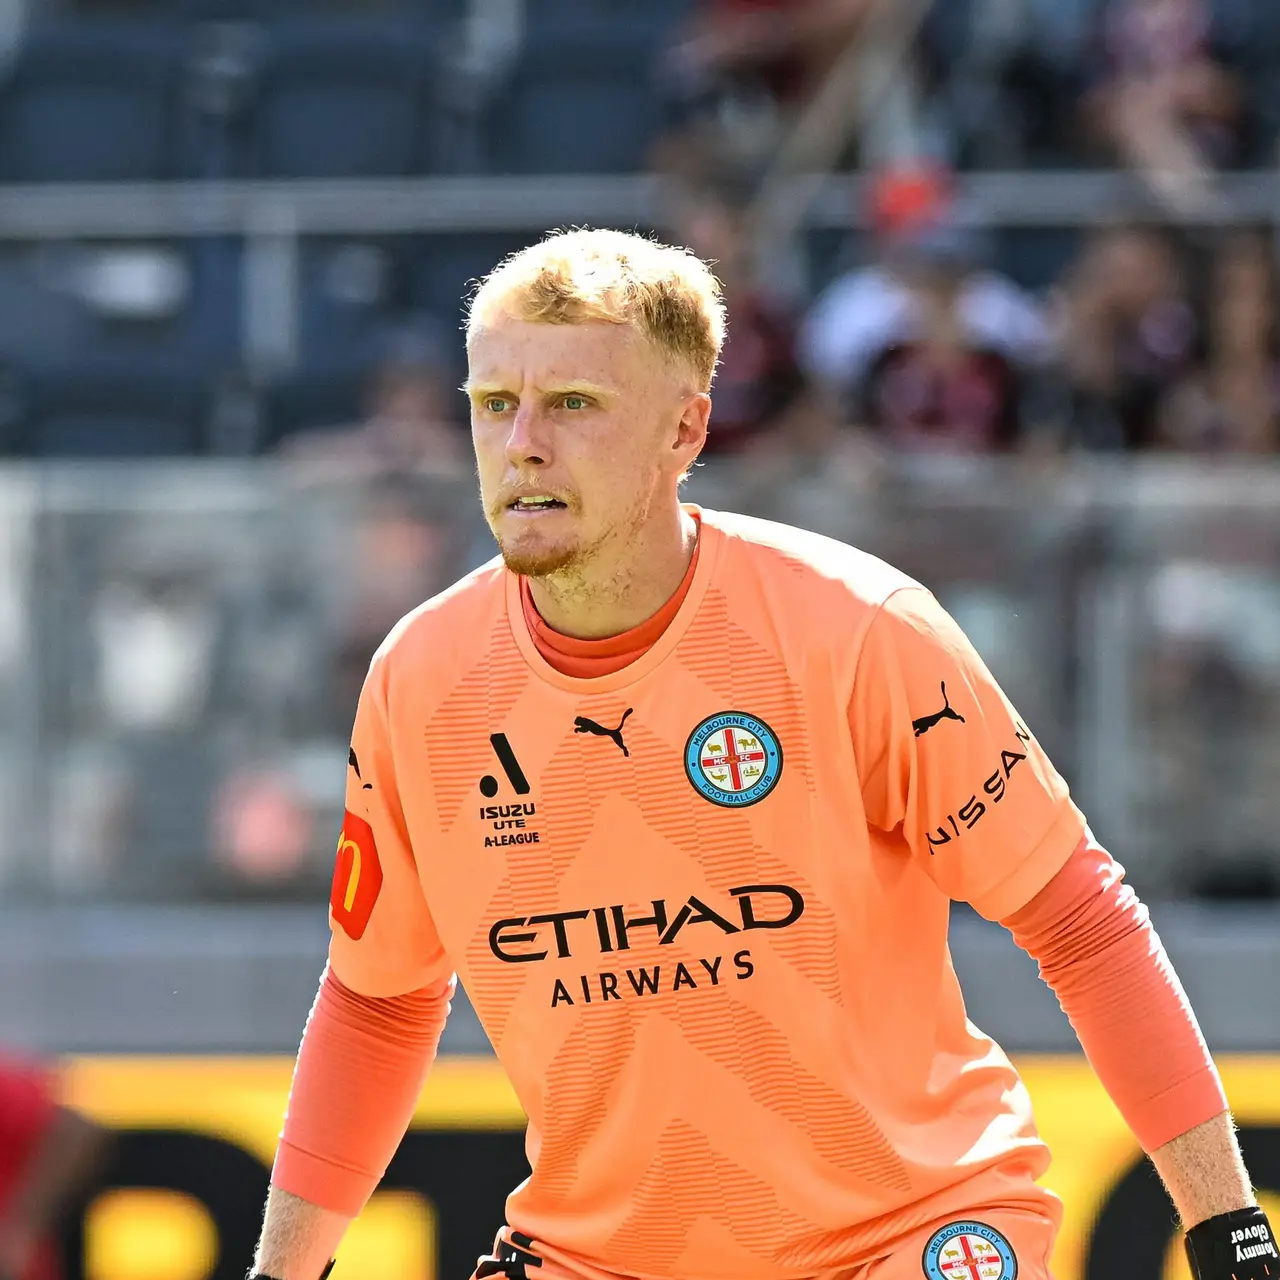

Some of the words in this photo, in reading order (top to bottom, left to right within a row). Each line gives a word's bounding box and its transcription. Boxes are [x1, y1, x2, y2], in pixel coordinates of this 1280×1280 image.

[693, 716, 745, 747] MELBOURNE
[747, 721, 768, 738] CITY
[701, 783, 752, 803] FOOTBALL
[752, 775, 773, 796] CLUB
[925, 721, 1031, 856] NISSAN
[480, 803, 536, 820] ISUZU
[493, 819, 526, 830] UTE
[484, 832, 540, 848] A-LEAGUE
[489, 884, 805, 963] ETIHAD
[551, 950, 755, 1007] AIRWAYS
[929, 1225, 978, 1254] MELBOURNE
[980, 1229, 1001, 1244] CITY
[1231, 1224, 1269, 1244] Glover
[1236, 1241, 1278, 1263] Tommy
